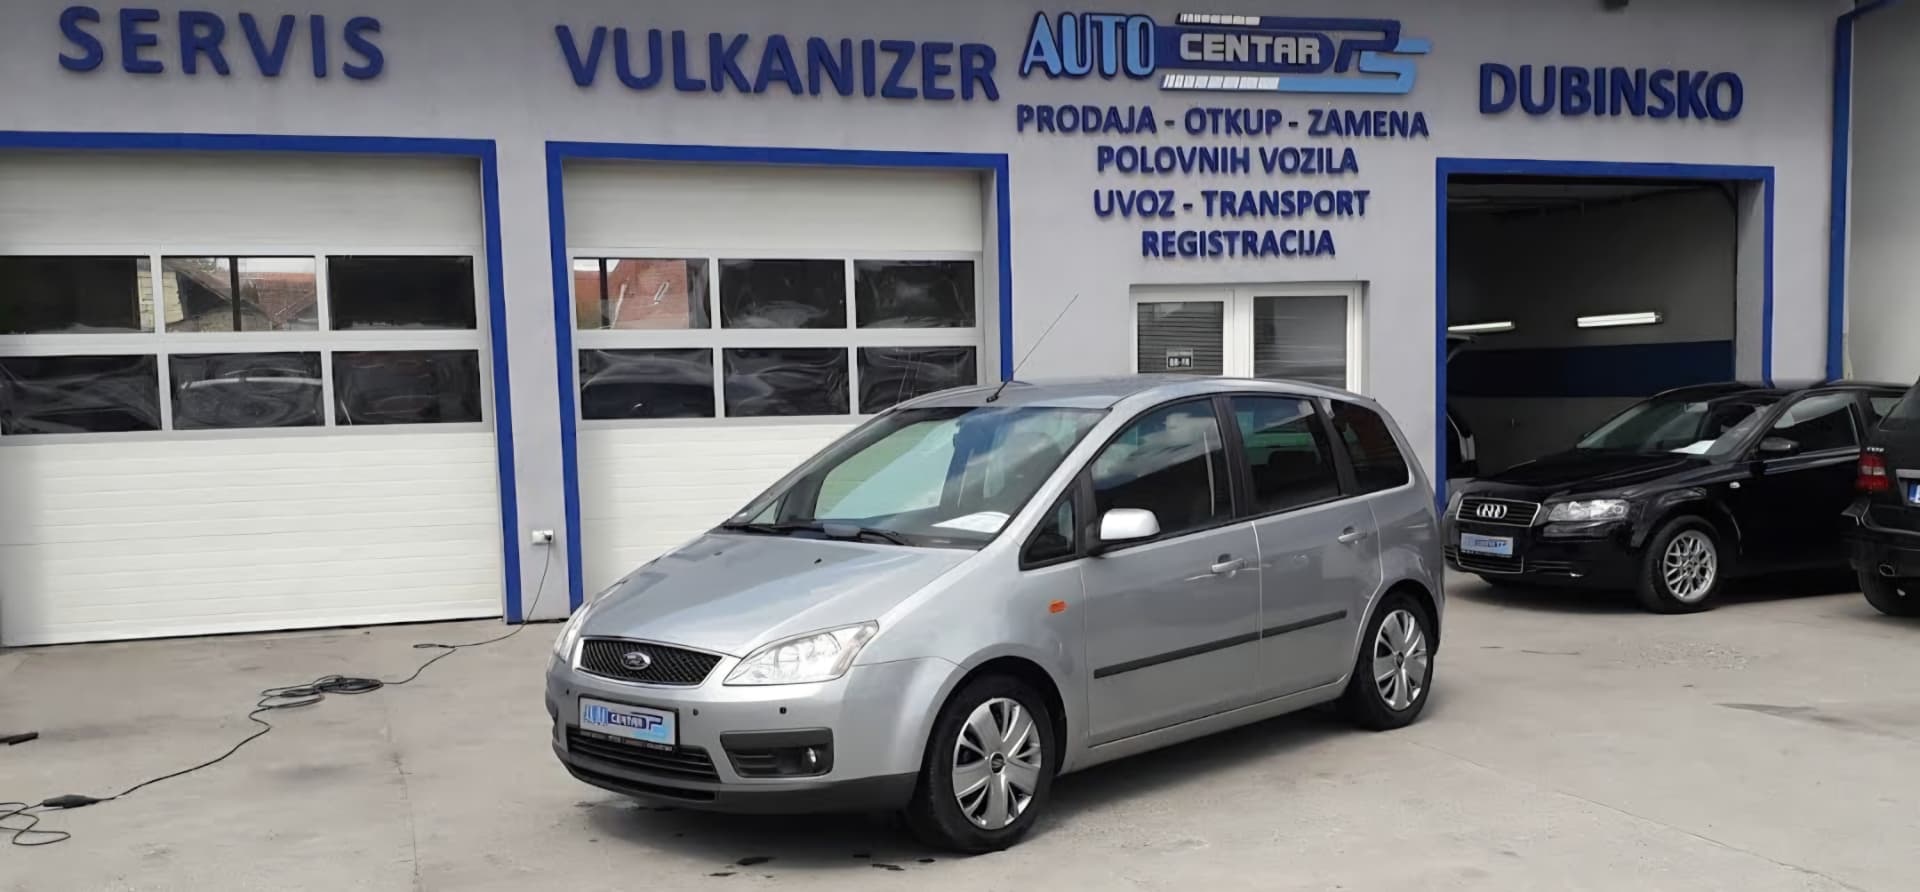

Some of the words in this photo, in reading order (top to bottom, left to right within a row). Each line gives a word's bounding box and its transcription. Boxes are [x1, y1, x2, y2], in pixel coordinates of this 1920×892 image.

[59, 6, 385, 80] SERVIS
[555, 24, 1000, 101] VULKANIZER
[1019, 11, 1157, 79] AUTO
[1179, 32, 1321, 65] CENTAR
[1479, 63, 1744, 121] DUBINSKO
[1016, 104, 1157, 134] PRODAJA
[1184, 107, 1283, 136] OTKUP
[1308, 108, 1430, 137] ZAMENA
[1096, 145, 1250, 175] POLOVNIH
[1259, 146, 1360, 175] VOZILA
[1093, 189, 1176, 217] UVOZ
[1200, 189, 1371, 217] TRANSPORT
[1141, 229, 1336, 258] REGISTRACIJA
